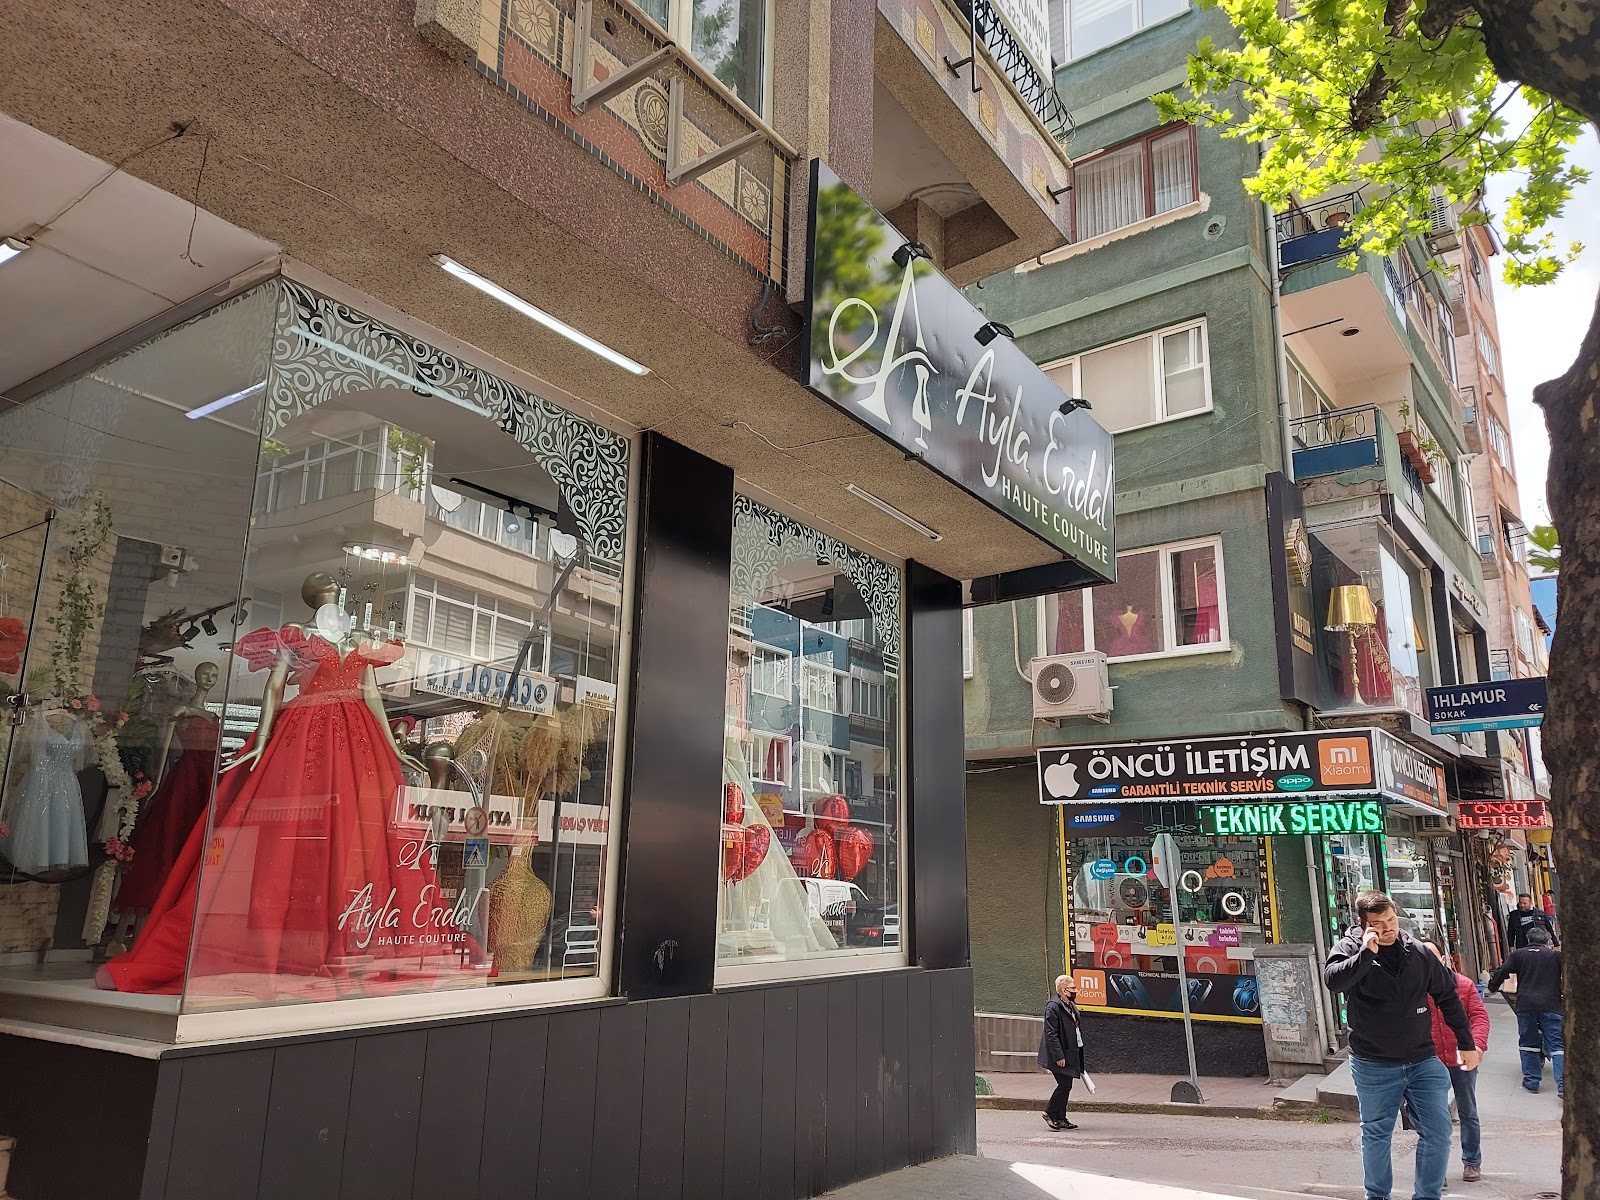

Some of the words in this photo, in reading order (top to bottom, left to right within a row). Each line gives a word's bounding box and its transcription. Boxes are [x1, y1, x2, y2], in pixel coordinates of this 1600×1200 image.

[956, 349, 1030, 487] Ayla
[1043, 410, 1112, 531] Erdal
[1002, 476, 1048, 525] HAUTE
[1053, 512, 1108, 564] COUTURE
[1434, 710, 1466, 720] SOKAK
[1088, 746, 1175, 779] ÖNCÜ
[1185, 739, 1310, 777] İLETİŞİM
[1322, 763, 1370, 776] Xiaomi
[1121, 781, 1180, 797] GARANTİLİ
[1183, 779, 1227, 794] TEKNİK
[1230, 777, 1275, 792] SERVİS
[1074, 814, 1115, 823] SAMSUNG
[338, 883, 401, 949] Ayla
[412, 884, 482, 929] Erdal
[1219, 927, 1236, 935] tablet
[378, 935, 415, 946] HAUTE
[419, 933, 467, 944] COUTURE
[1218, 935, 1238, 943] telefon
[1077, 989, 1105, 999] Xiaomi
